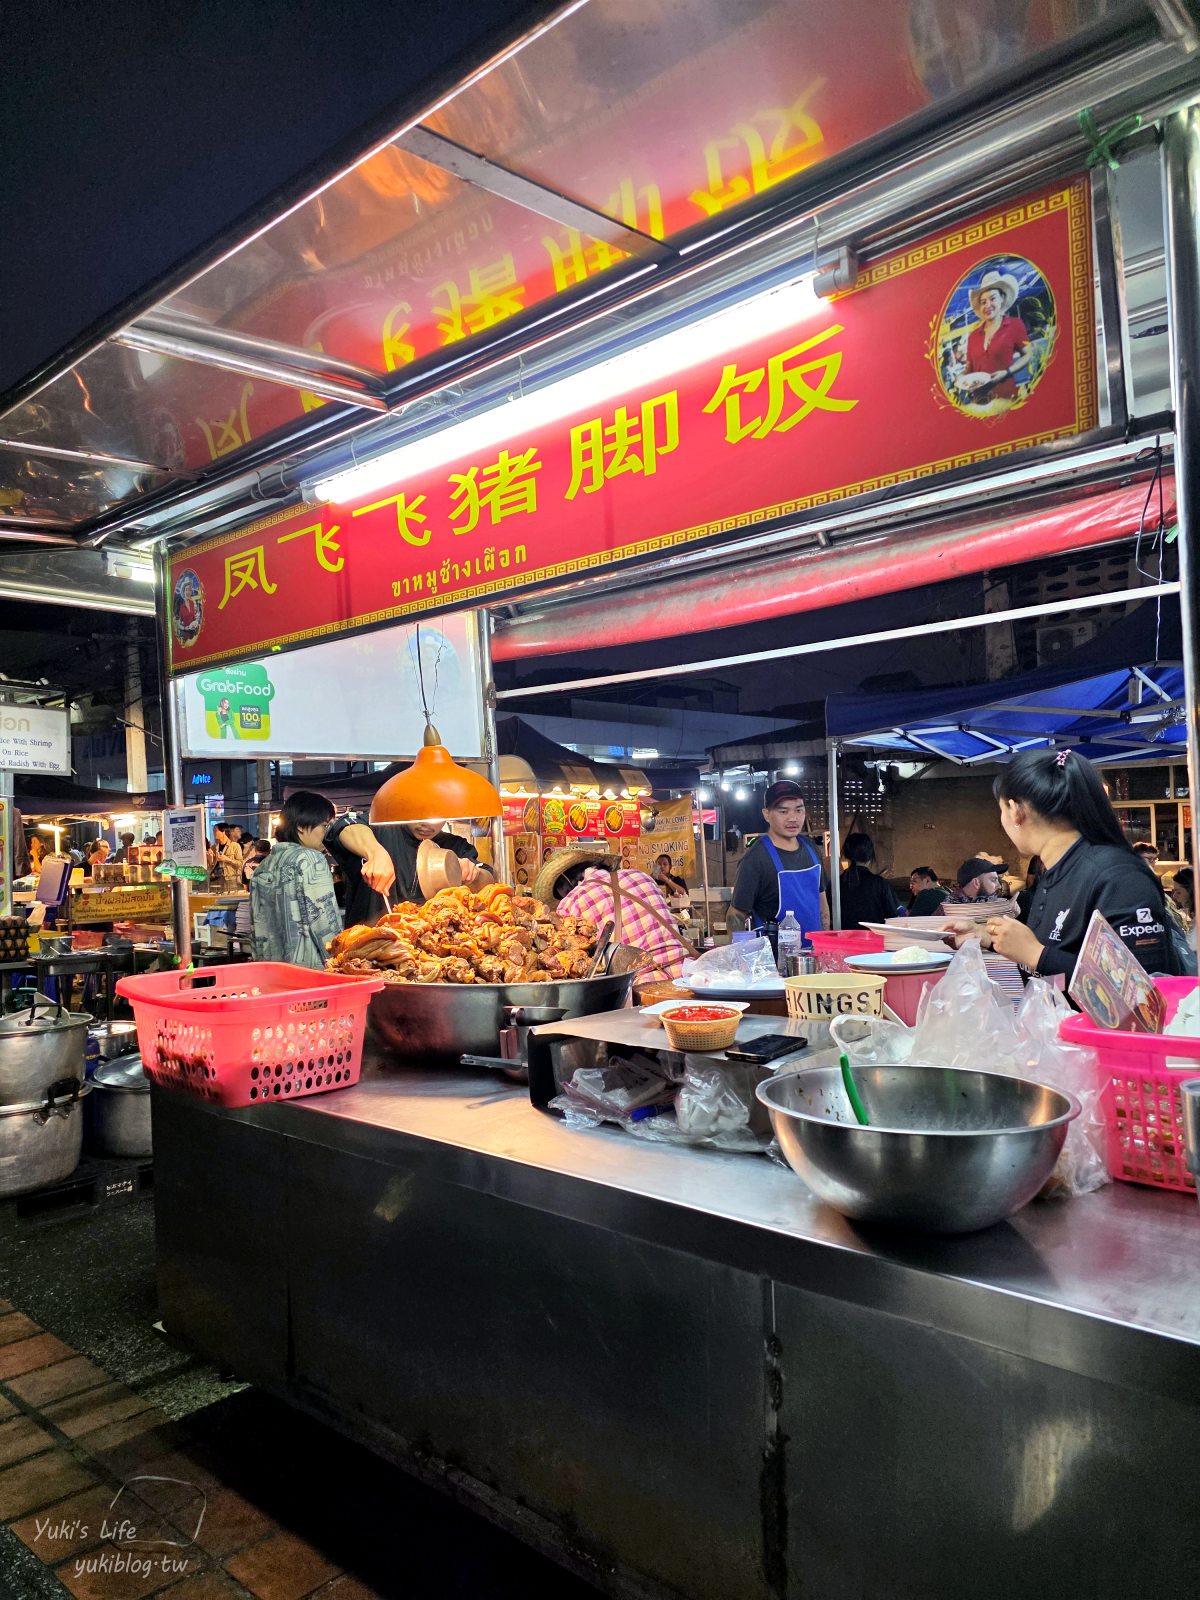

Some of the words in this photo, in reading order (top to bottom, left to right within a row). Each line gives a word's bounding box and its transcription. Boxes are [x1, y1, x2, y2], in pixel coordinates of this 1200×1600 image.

[217, 324, 859, 611] 凤飞飞猪脚饭
[391, 544, 527, 597] ขาหมูช้างเผือก
[200, 678, 271, 696] GrabFood
[13, 738, 27, 746] With
[30, 739, 53, 748] Shrimp
[2, 748, 12, 756] On
[14, 749, 29, 757] Rice
[8, 759, 30, 768] Radish
[32, 761, 47, 769] With
[651, 840, 689, 855] SMOKING
